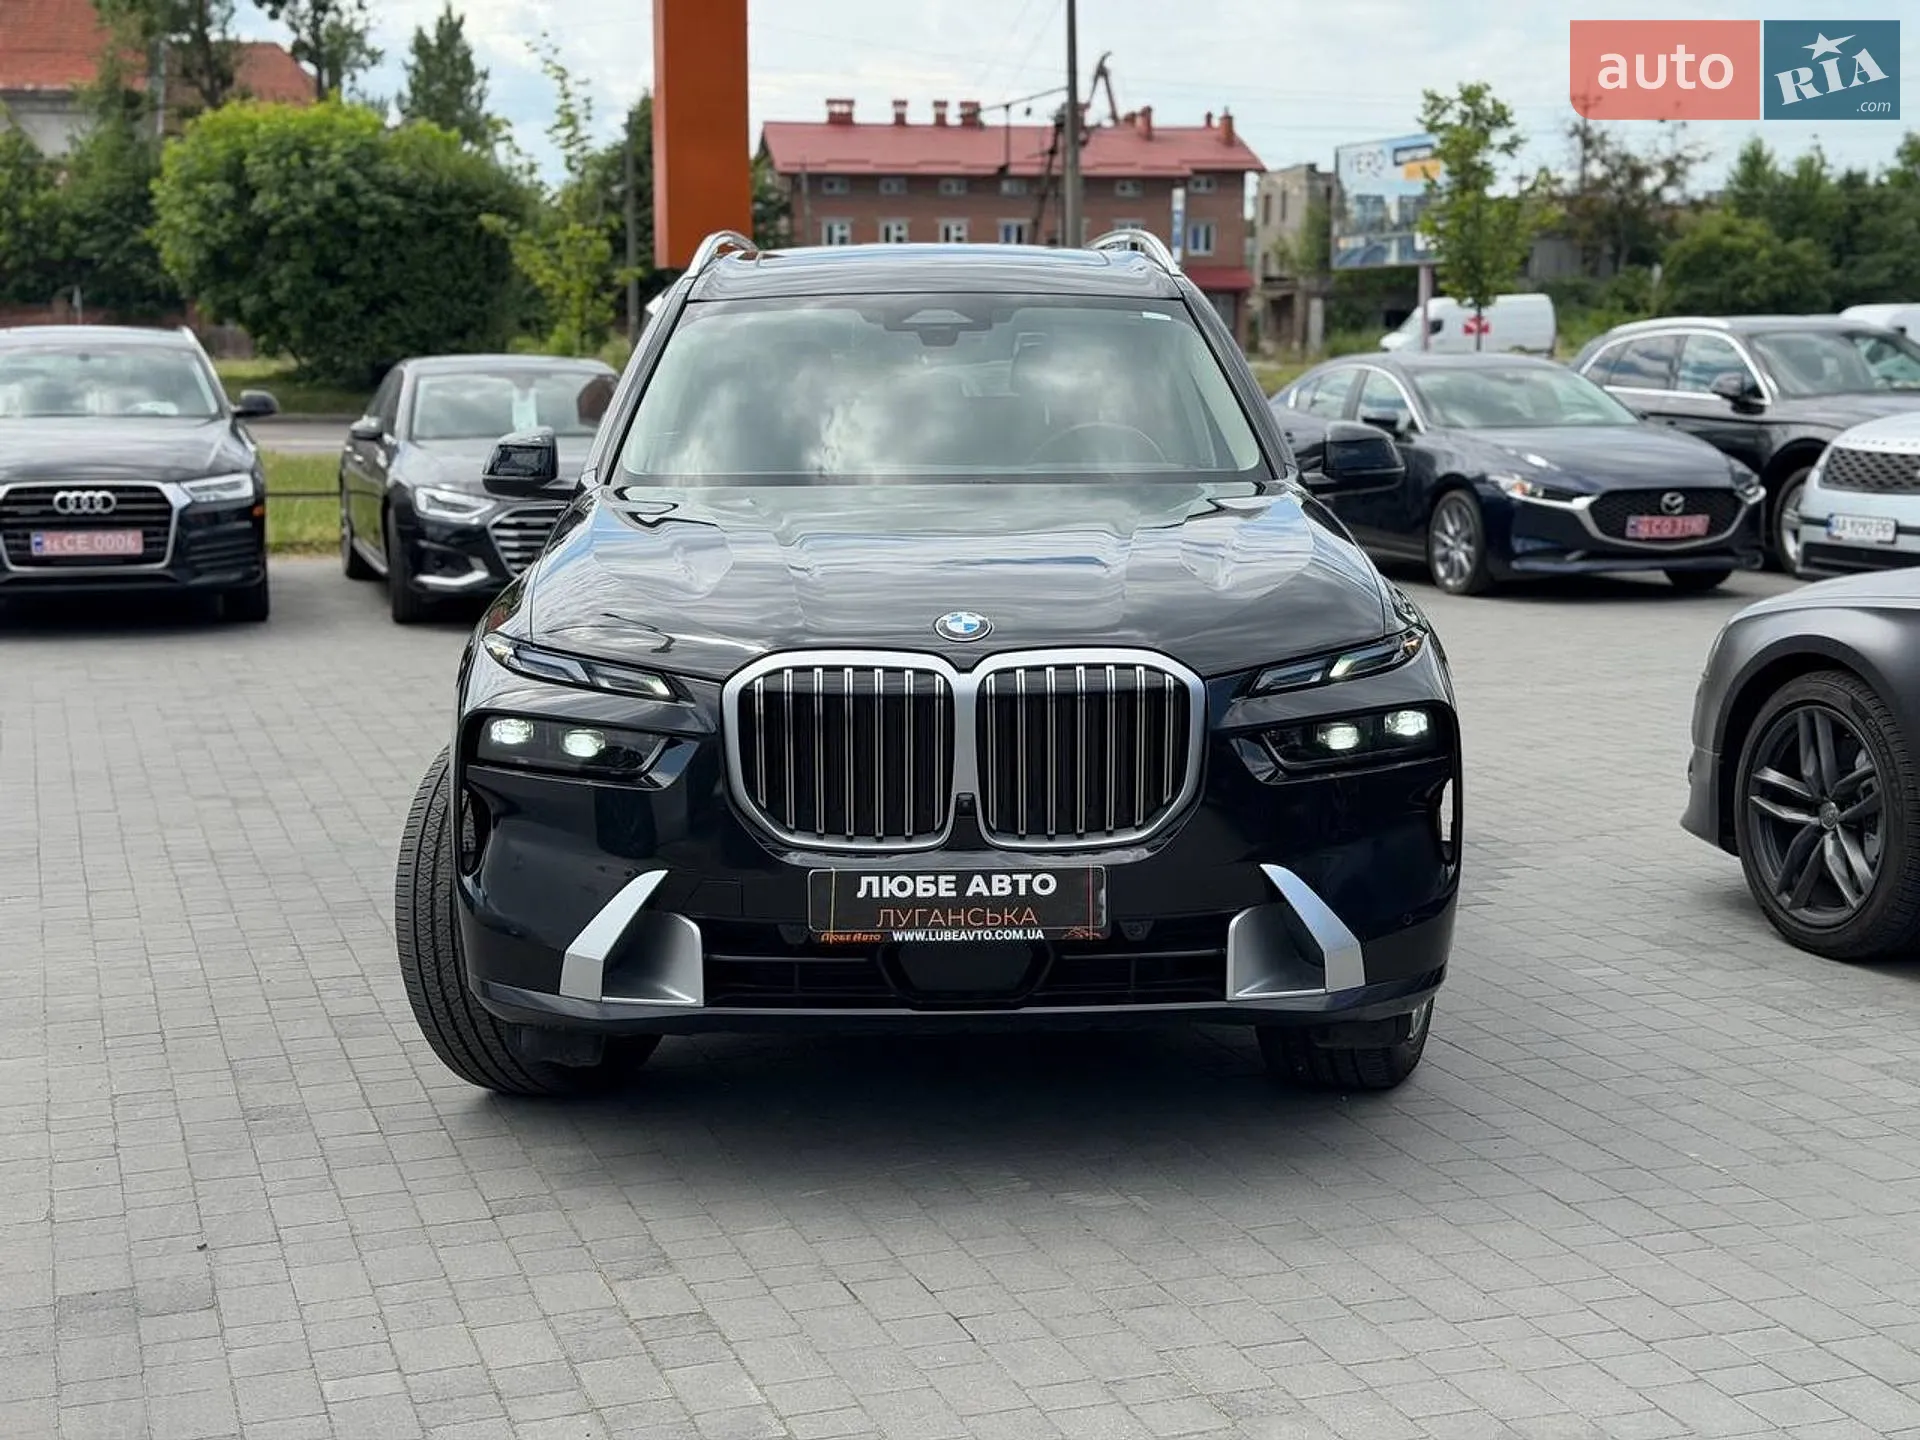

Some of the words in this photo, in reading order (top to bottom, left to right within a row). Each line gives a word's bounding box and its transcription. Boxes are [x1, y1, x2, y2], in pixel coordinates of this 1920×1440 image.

[856, 875, 957, 899] ЛЮБЕ
[965, 873, 1058, 897] АВТО
[876, 906, 1039, 928] ЛУГАНСЬКА
[891, 928, 1045, 942] WWW.LUBEAVTO.COM.UA
